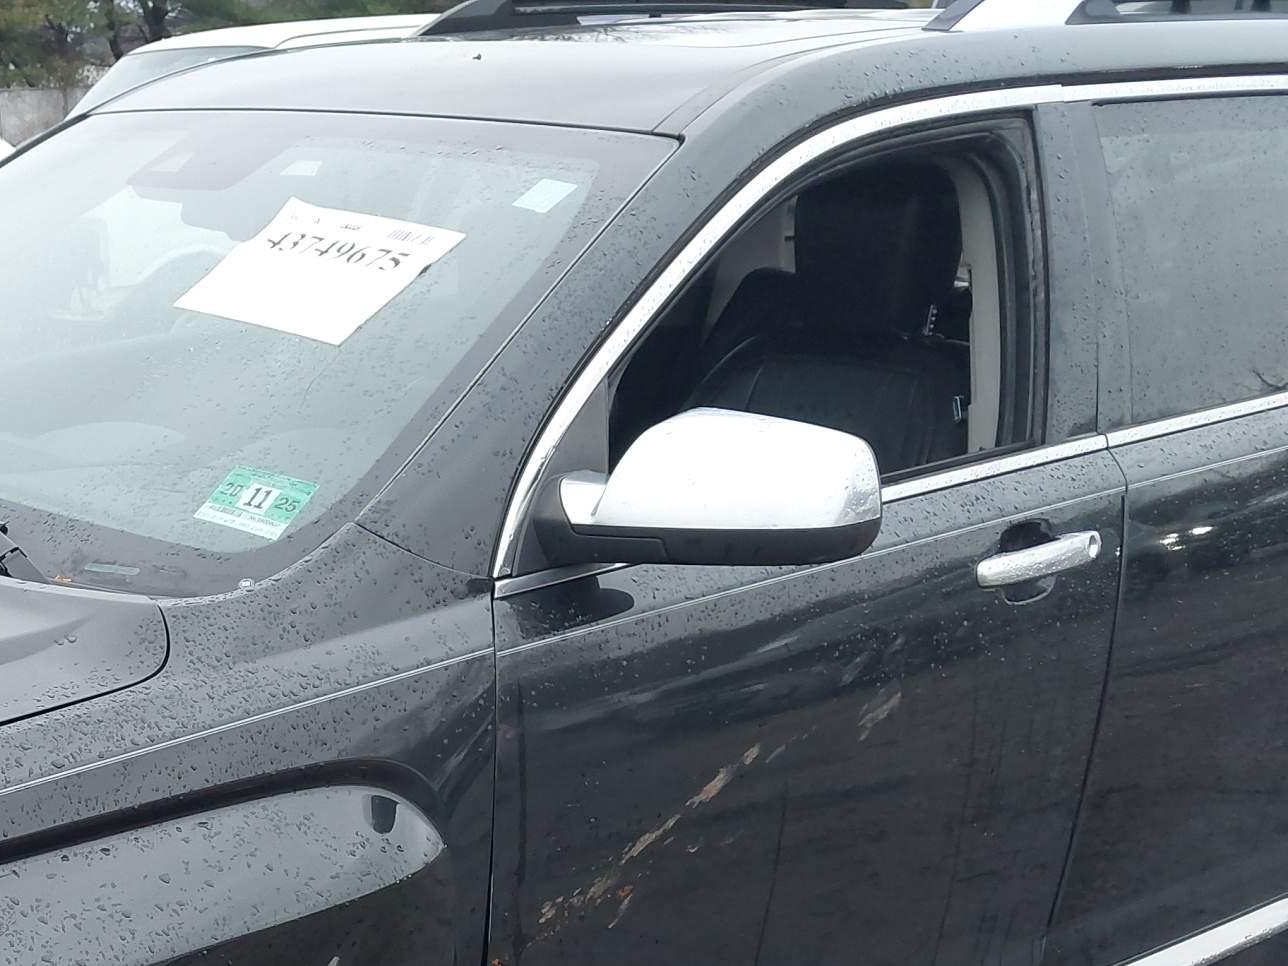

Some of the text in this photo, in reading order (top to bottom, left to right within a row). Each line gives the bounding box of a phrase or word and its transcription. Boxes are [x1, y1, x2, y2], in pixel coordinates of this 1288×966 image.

[266, 231, 412, 271] 43749675
[219, 482, 300, 513] 20 11 25
